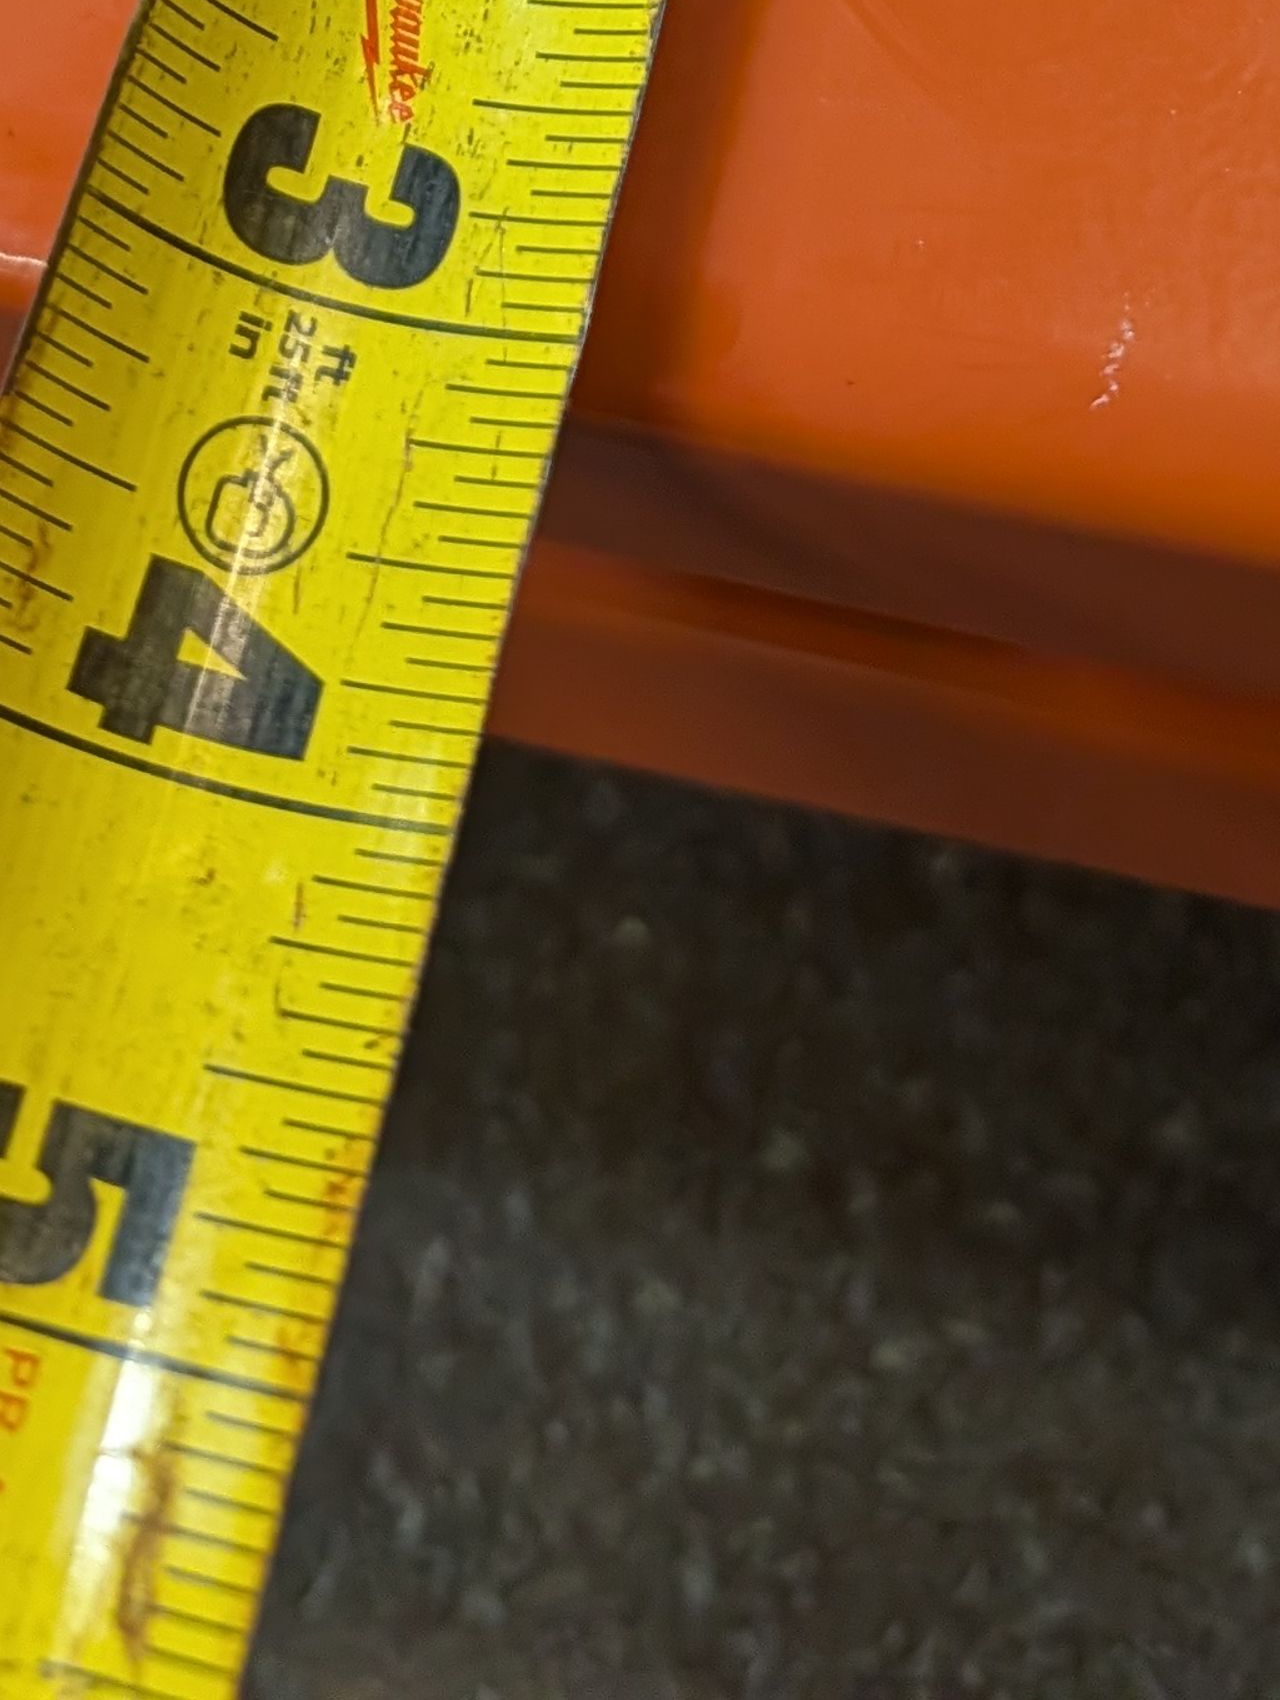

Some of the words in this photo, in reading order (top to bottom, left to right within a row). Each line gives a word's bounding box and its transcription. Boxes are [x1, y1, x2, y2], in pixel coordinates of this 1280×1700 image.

[222, 102, 461, 290] 3
[228, 310, 274, 360] in
[314, 343, 358, 387] ft
[67, 554, 324, 761] 4
